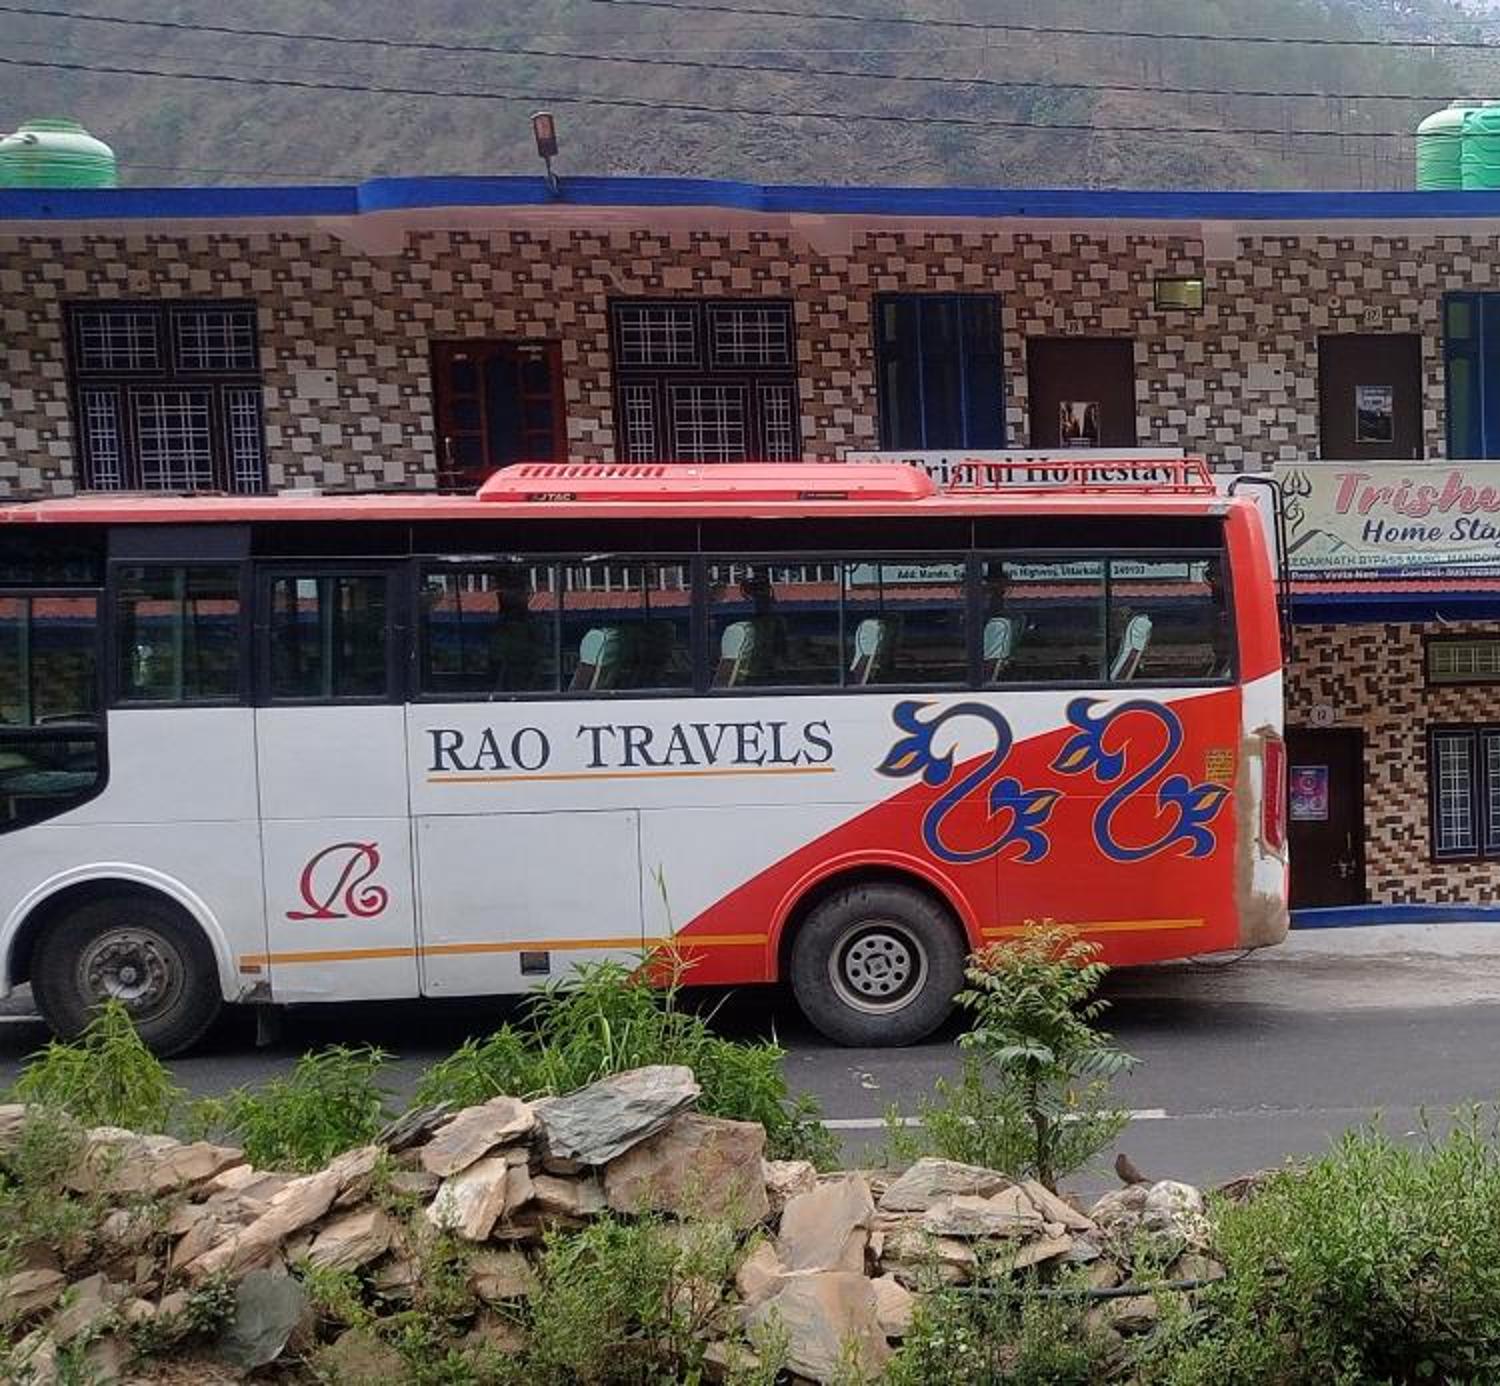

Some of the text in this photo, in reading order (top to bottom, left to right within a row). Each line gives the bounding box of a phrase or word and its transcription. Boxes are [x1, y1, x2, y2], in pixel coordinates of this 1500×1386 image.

[1362, 519, 1444, 543] Home
[1288, 555, 1354, 567] EDARNATH
[427, 719, 834, 771] RAO TRAVELS
